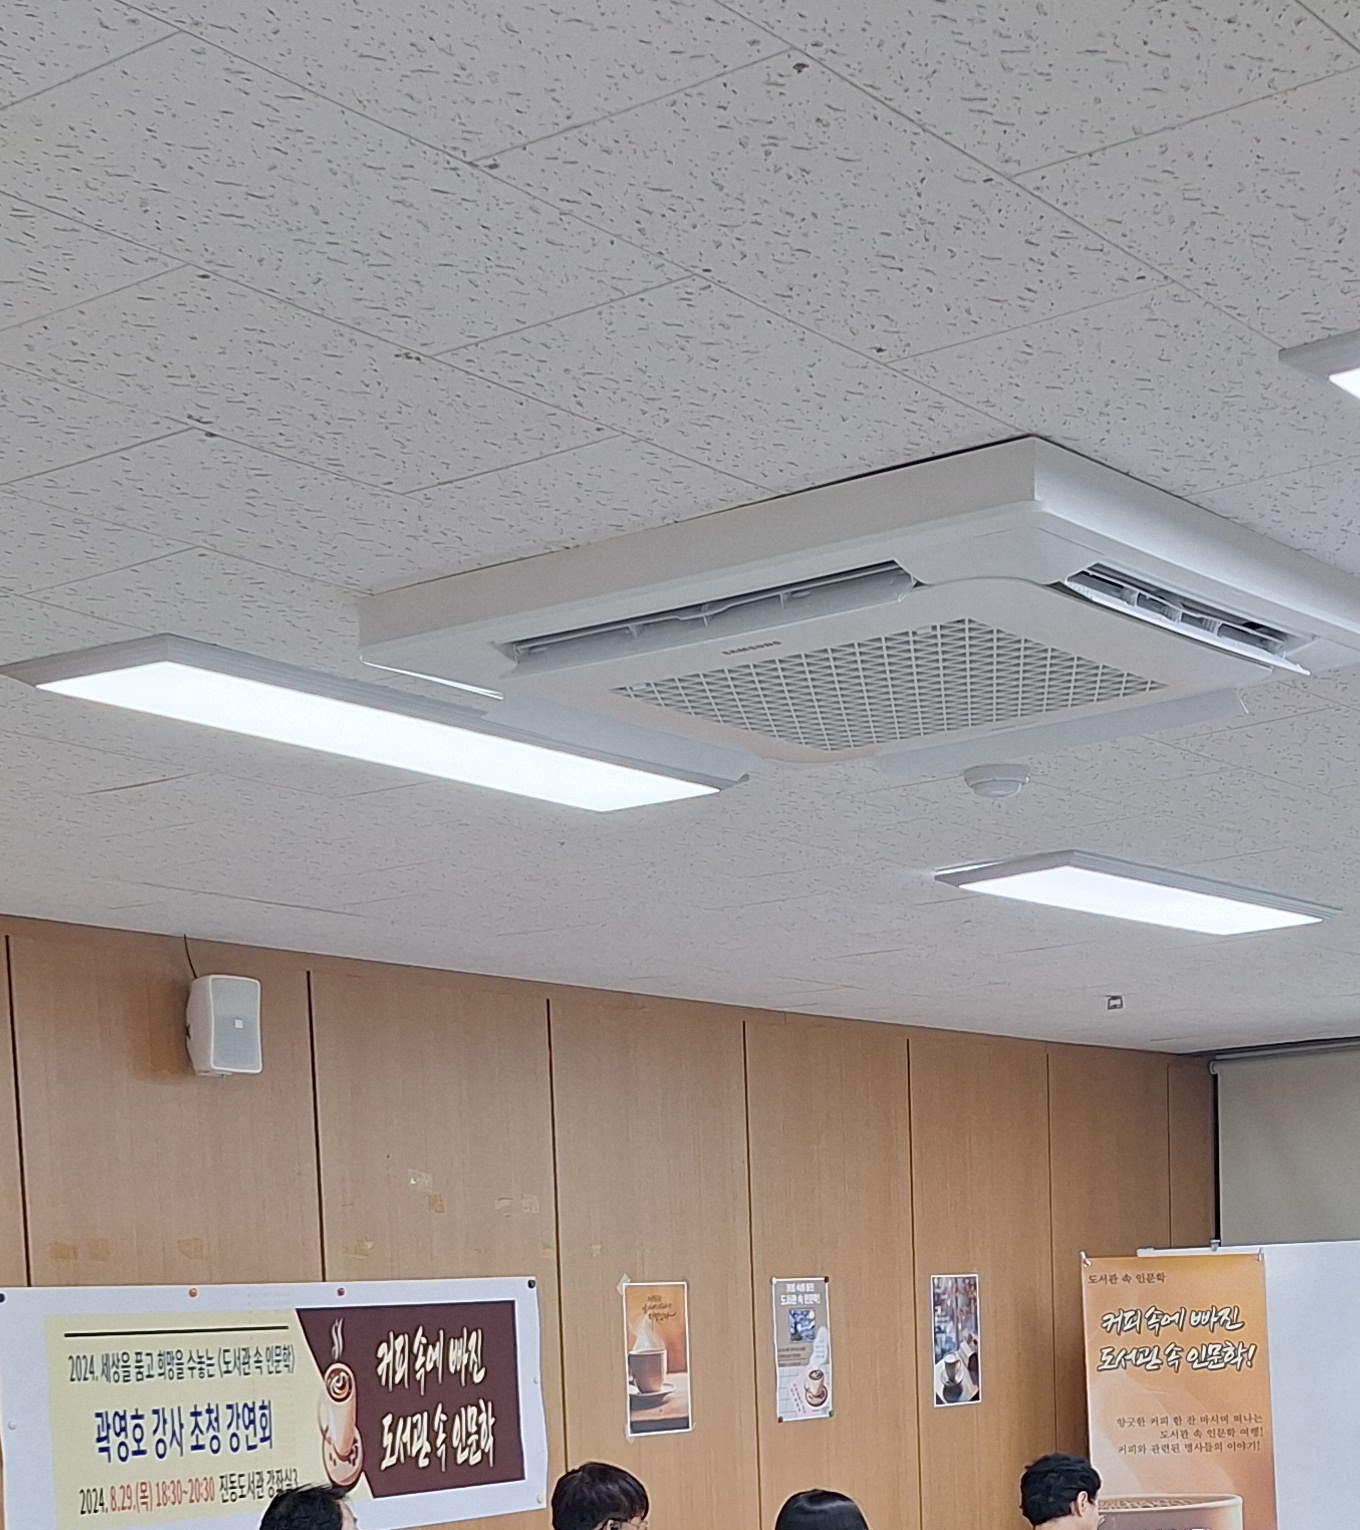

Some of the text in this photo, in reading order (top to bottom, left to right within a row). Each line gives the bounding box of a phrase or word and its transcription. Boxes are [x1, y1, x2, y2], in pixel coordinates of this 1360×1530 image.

[1088, 1272, 1166, 1285] 도서관 속 인문학
[1101, 1305, 1245, 1337] 커피 속에 빠진
[68, 1354, 99, 1382] 2024.
[101, 1351, 132, 1383] 세상을
[134, 1351, 155, 1382] 품고
[157, 1349, 185, 1381] 희망을
[186, 1348, 215, 1379] 수놓는
[253, 1346, 263, 1376] 속
[376, 1324, 487, 1396] 커피 속에 빠진
[1097, 1340, 1257, 1373] 도서관 속 인문학!
[94, 1399, 273, 1463] 곽영호 강사 초청 강연회
[380, 1398, 496, 1472] 도서관 속 인문학
[1117, 1413, 1263, 1428] 향긋한 커피 한 잔 마시며 떠나는
[1160, 1428, 1189, 1439] 도서관
[1193, 1428, 1203, 1439] 속
[1207, 1428, 1236, 1438] 인문학
[1118, 1444, 1147, 1455] 커피와
[1151, 1443, 1180, 1454] 관련된
[1185, 1441, 1223, 1453] 명사들의
[79, 1487, 108, 1515] 2024.
[109, 1480, 153, 1513] 8.29.(목)
[155, 1476, 216, 1508] 18:30~20:30
[218, 1470, 265, 1504] 진동도서관
